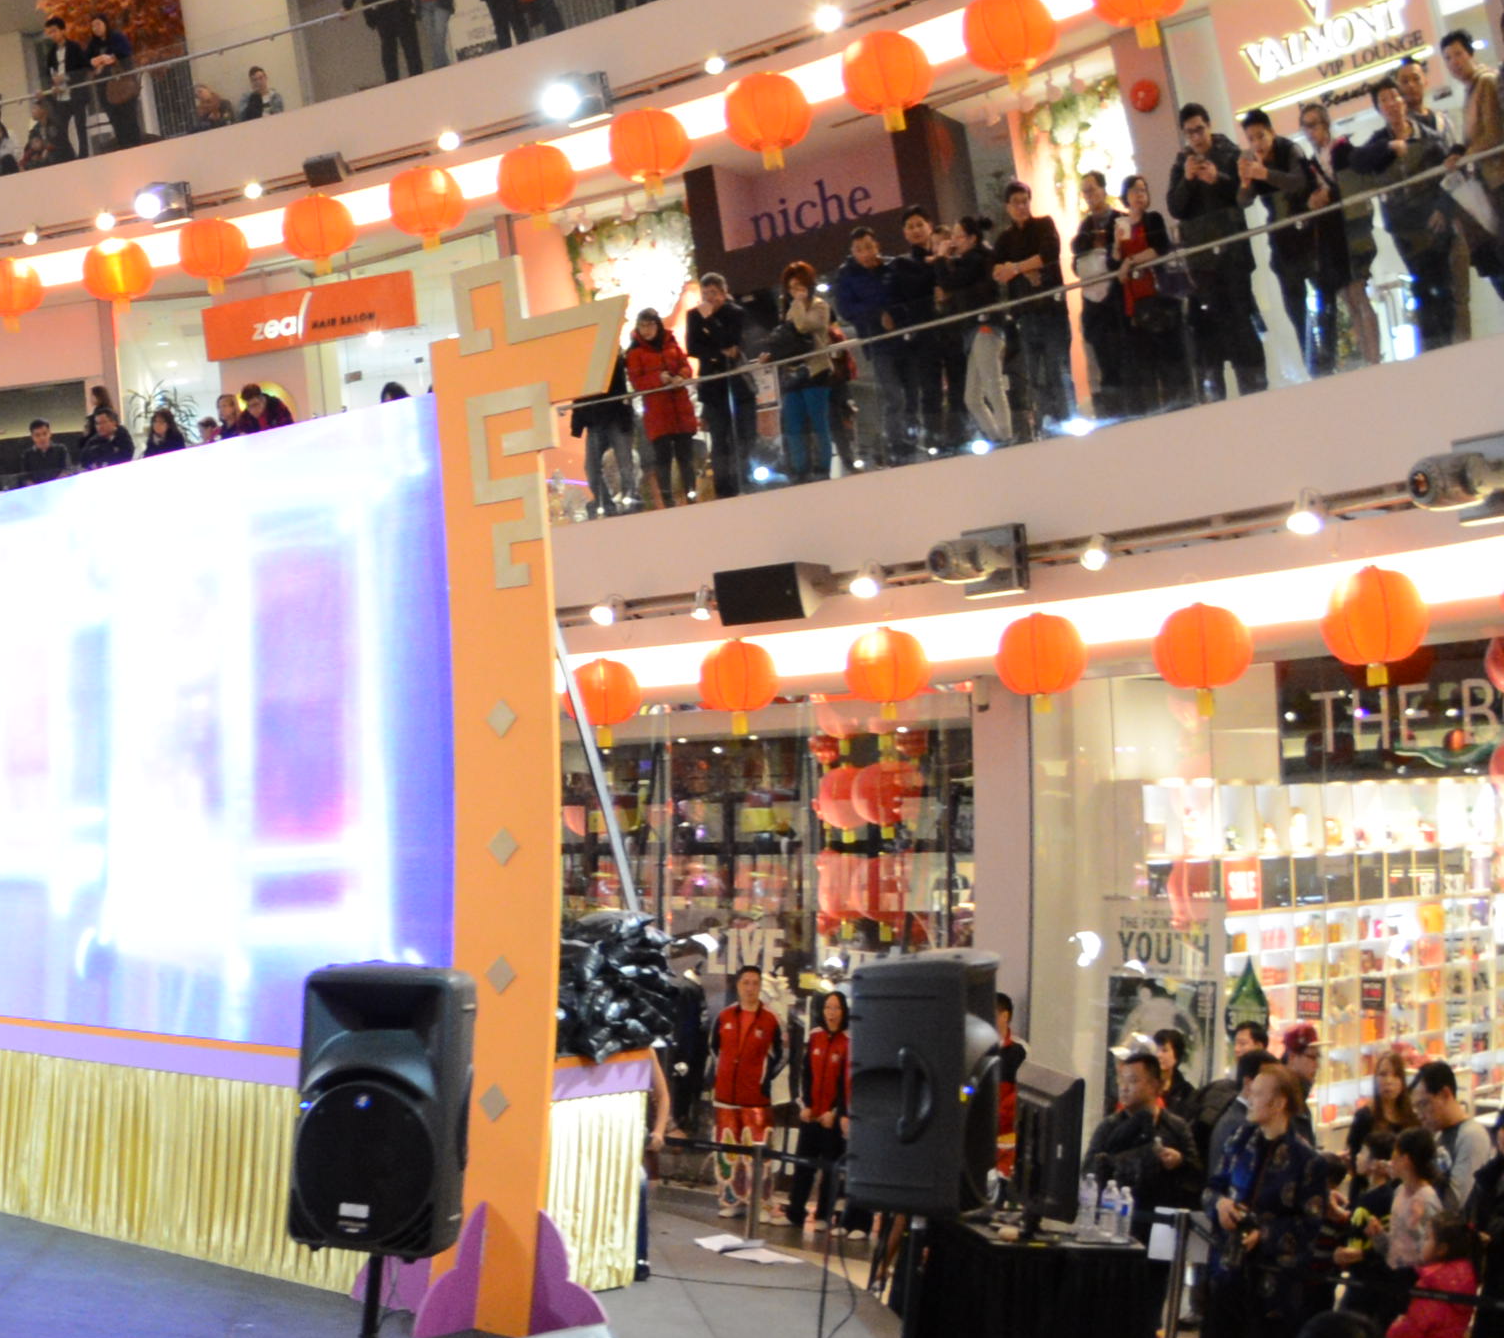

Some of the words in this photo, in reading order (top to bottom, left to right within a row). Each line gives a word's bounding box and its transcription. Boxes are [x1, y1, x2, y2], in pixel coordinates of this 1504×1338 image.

[1317, 59, 1345, 79] VIP
[1351, 30, 1425, 68] LOUNGE
[750, 179, 873, 245] niche
[251, 291, 313, 341] zeal
[311, 317, 337, 330] HAIR
[340, 311, 376, 326] SALON
[1309, 682, 1429, 754] THE
[706, 925, 785, 975] LIVE
